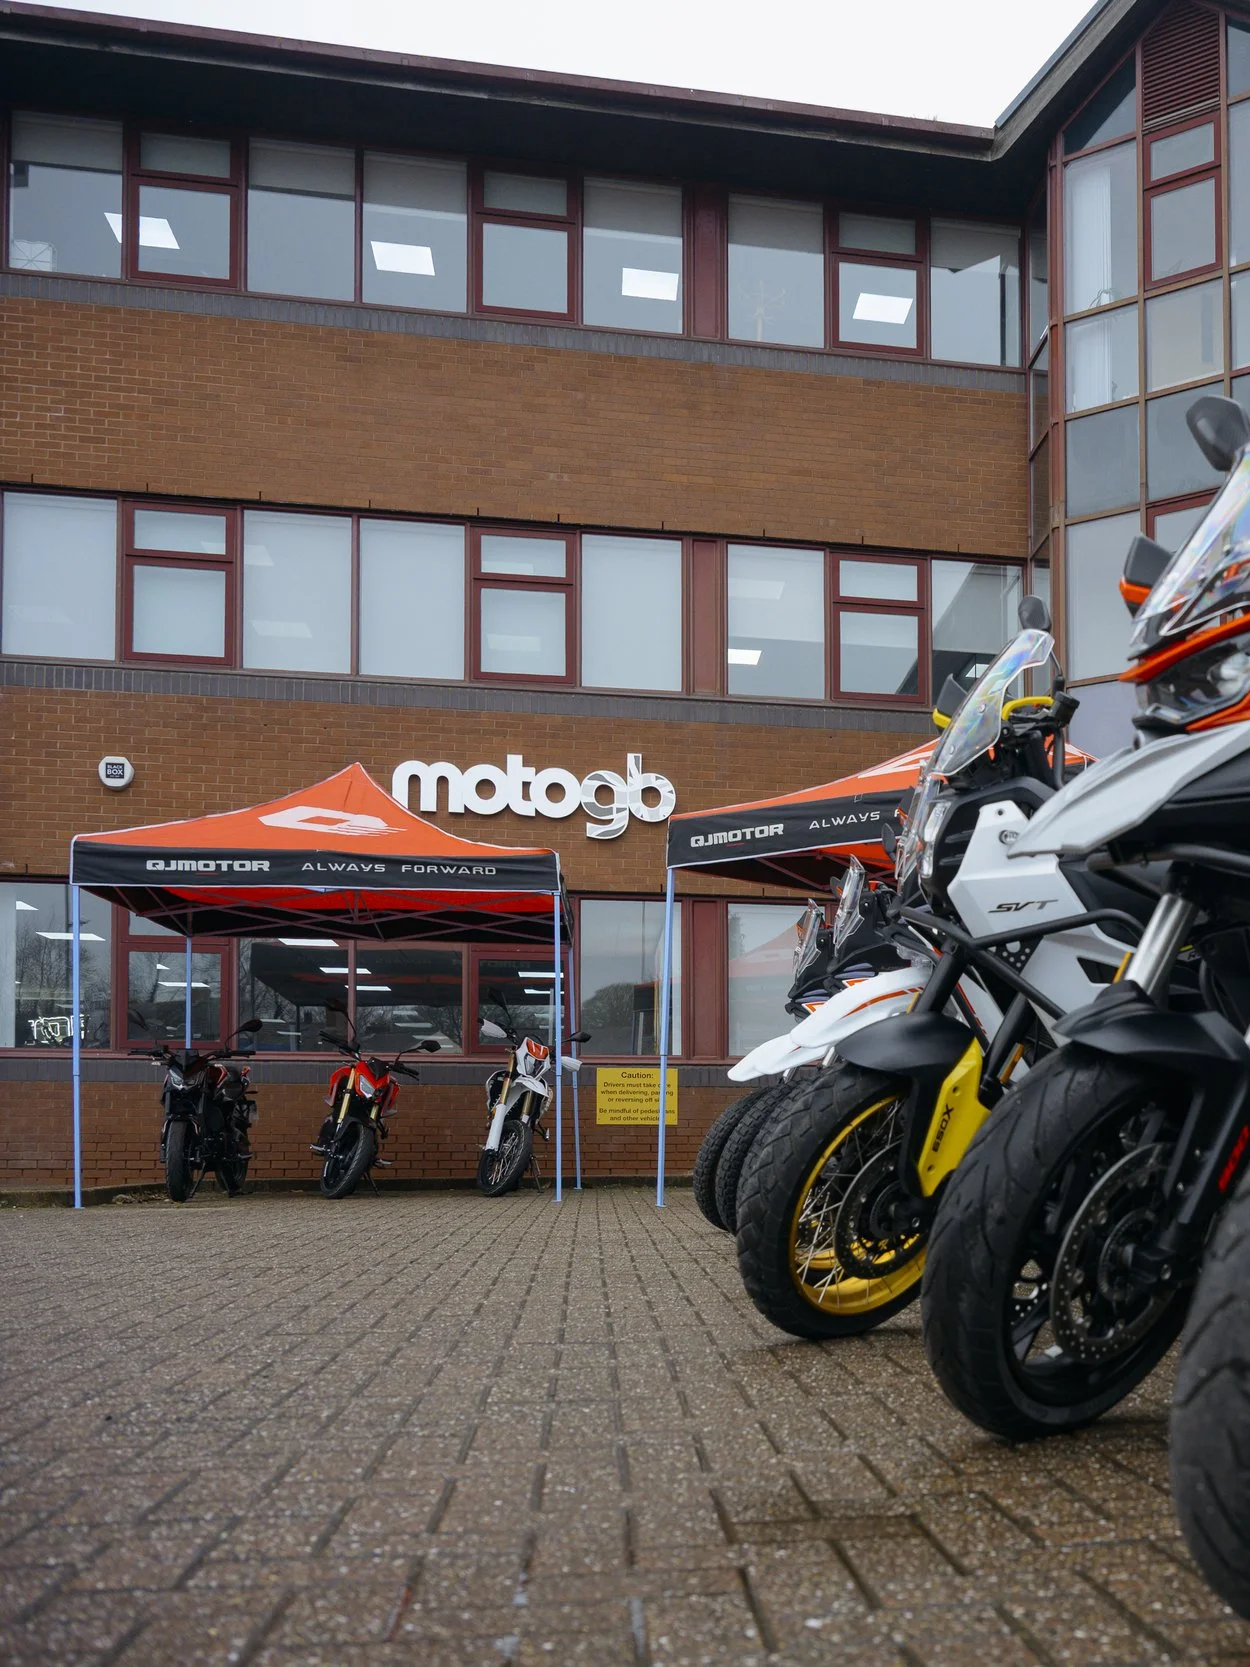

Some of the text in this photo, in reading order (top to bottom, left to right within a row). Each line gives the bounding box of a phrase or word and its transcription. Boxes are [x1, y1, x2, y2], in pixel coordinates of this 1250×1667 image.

[392, 753, 676, 839] motogb
[690, 823, 784, 848] QJMOTOR
[809, 811, 881, 829] ALWAYS
[146, 860, 496, 875] QJMOTOR ALWAYS FORWARD
[988, 899, 1059, 913] SVT
